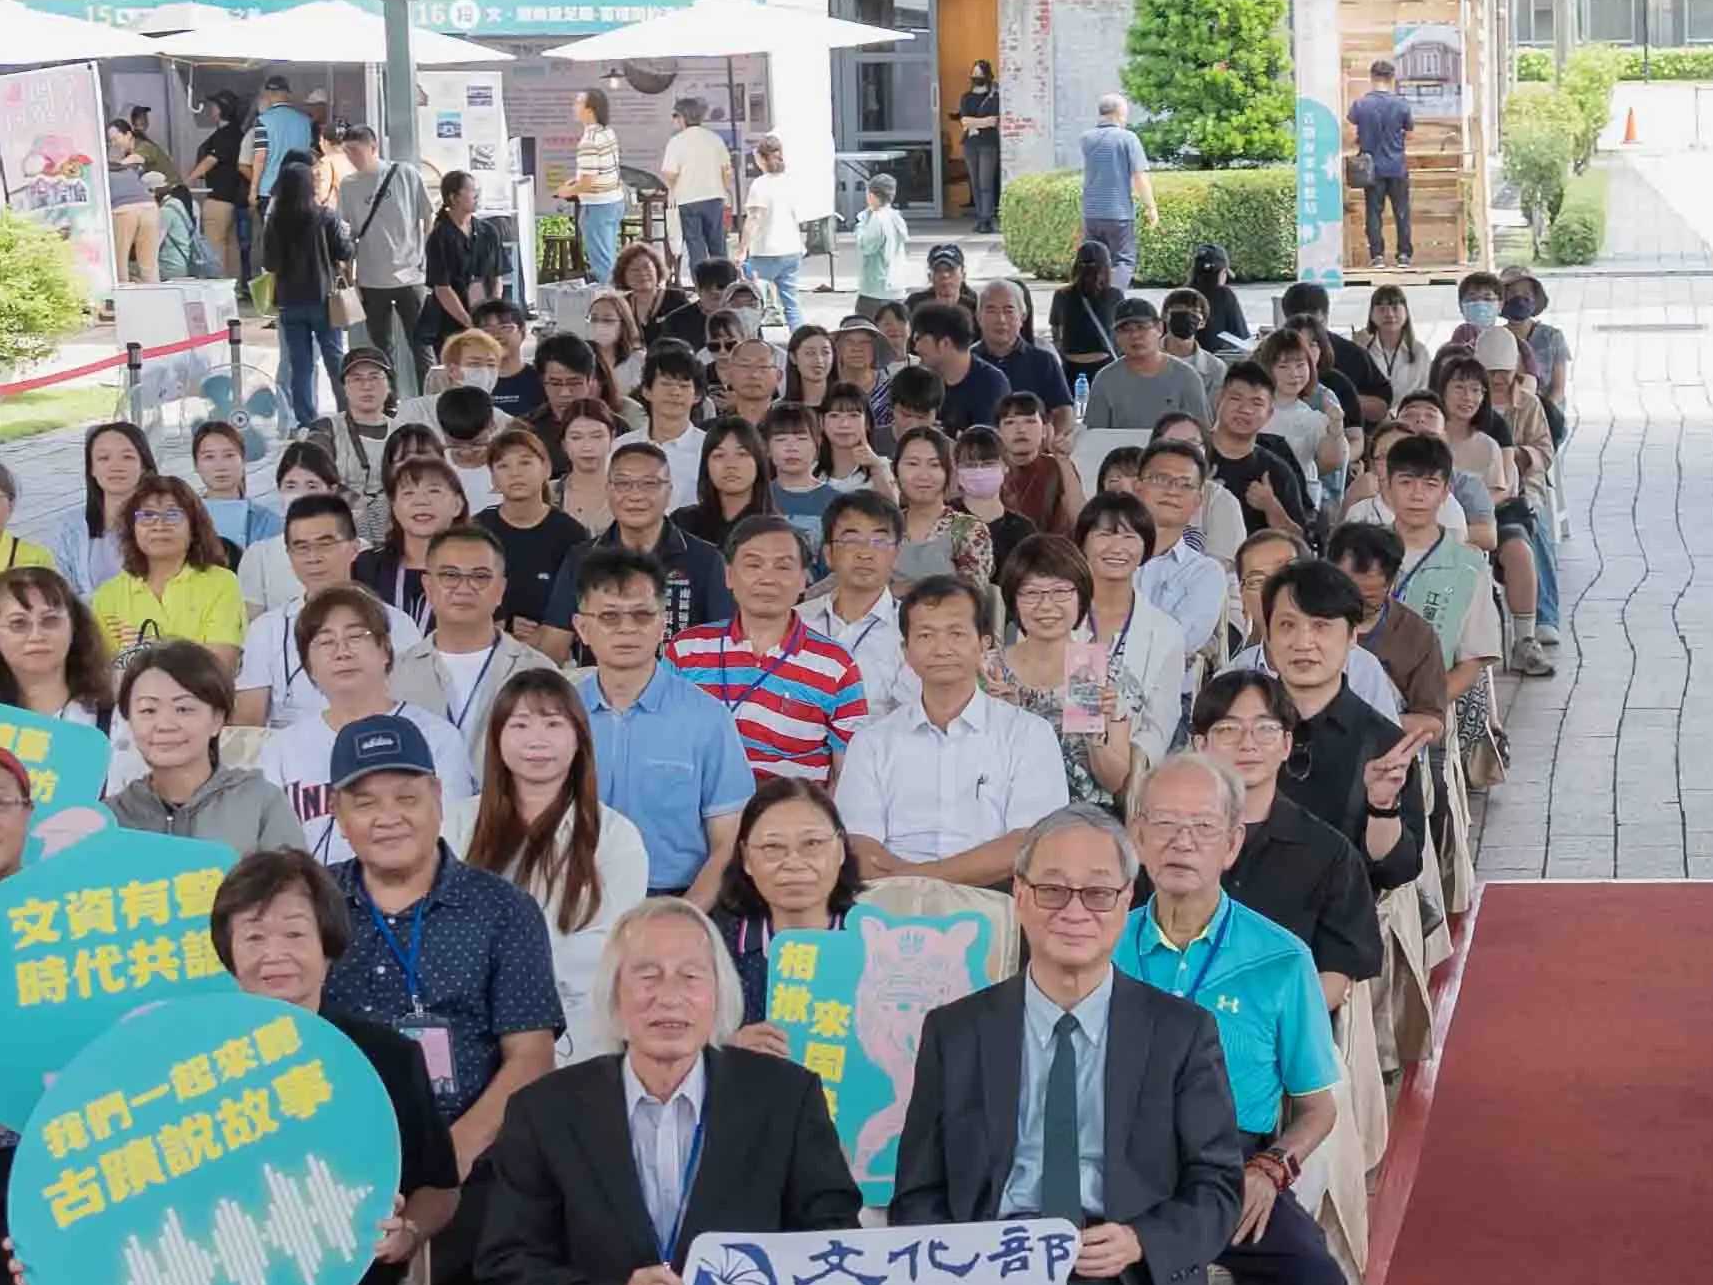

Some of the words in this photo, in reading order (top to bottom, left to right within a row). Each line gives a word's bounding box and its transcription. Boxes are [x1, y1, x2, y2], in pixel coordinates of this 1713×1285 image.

[7, 867, 225, 951] 文資有聲
[42, 1014, 303, 1159] 我們一起來聽
[804, 999, 852, 1124] 來開
[42, 1058, 333, 1229] 古蹟說故事
